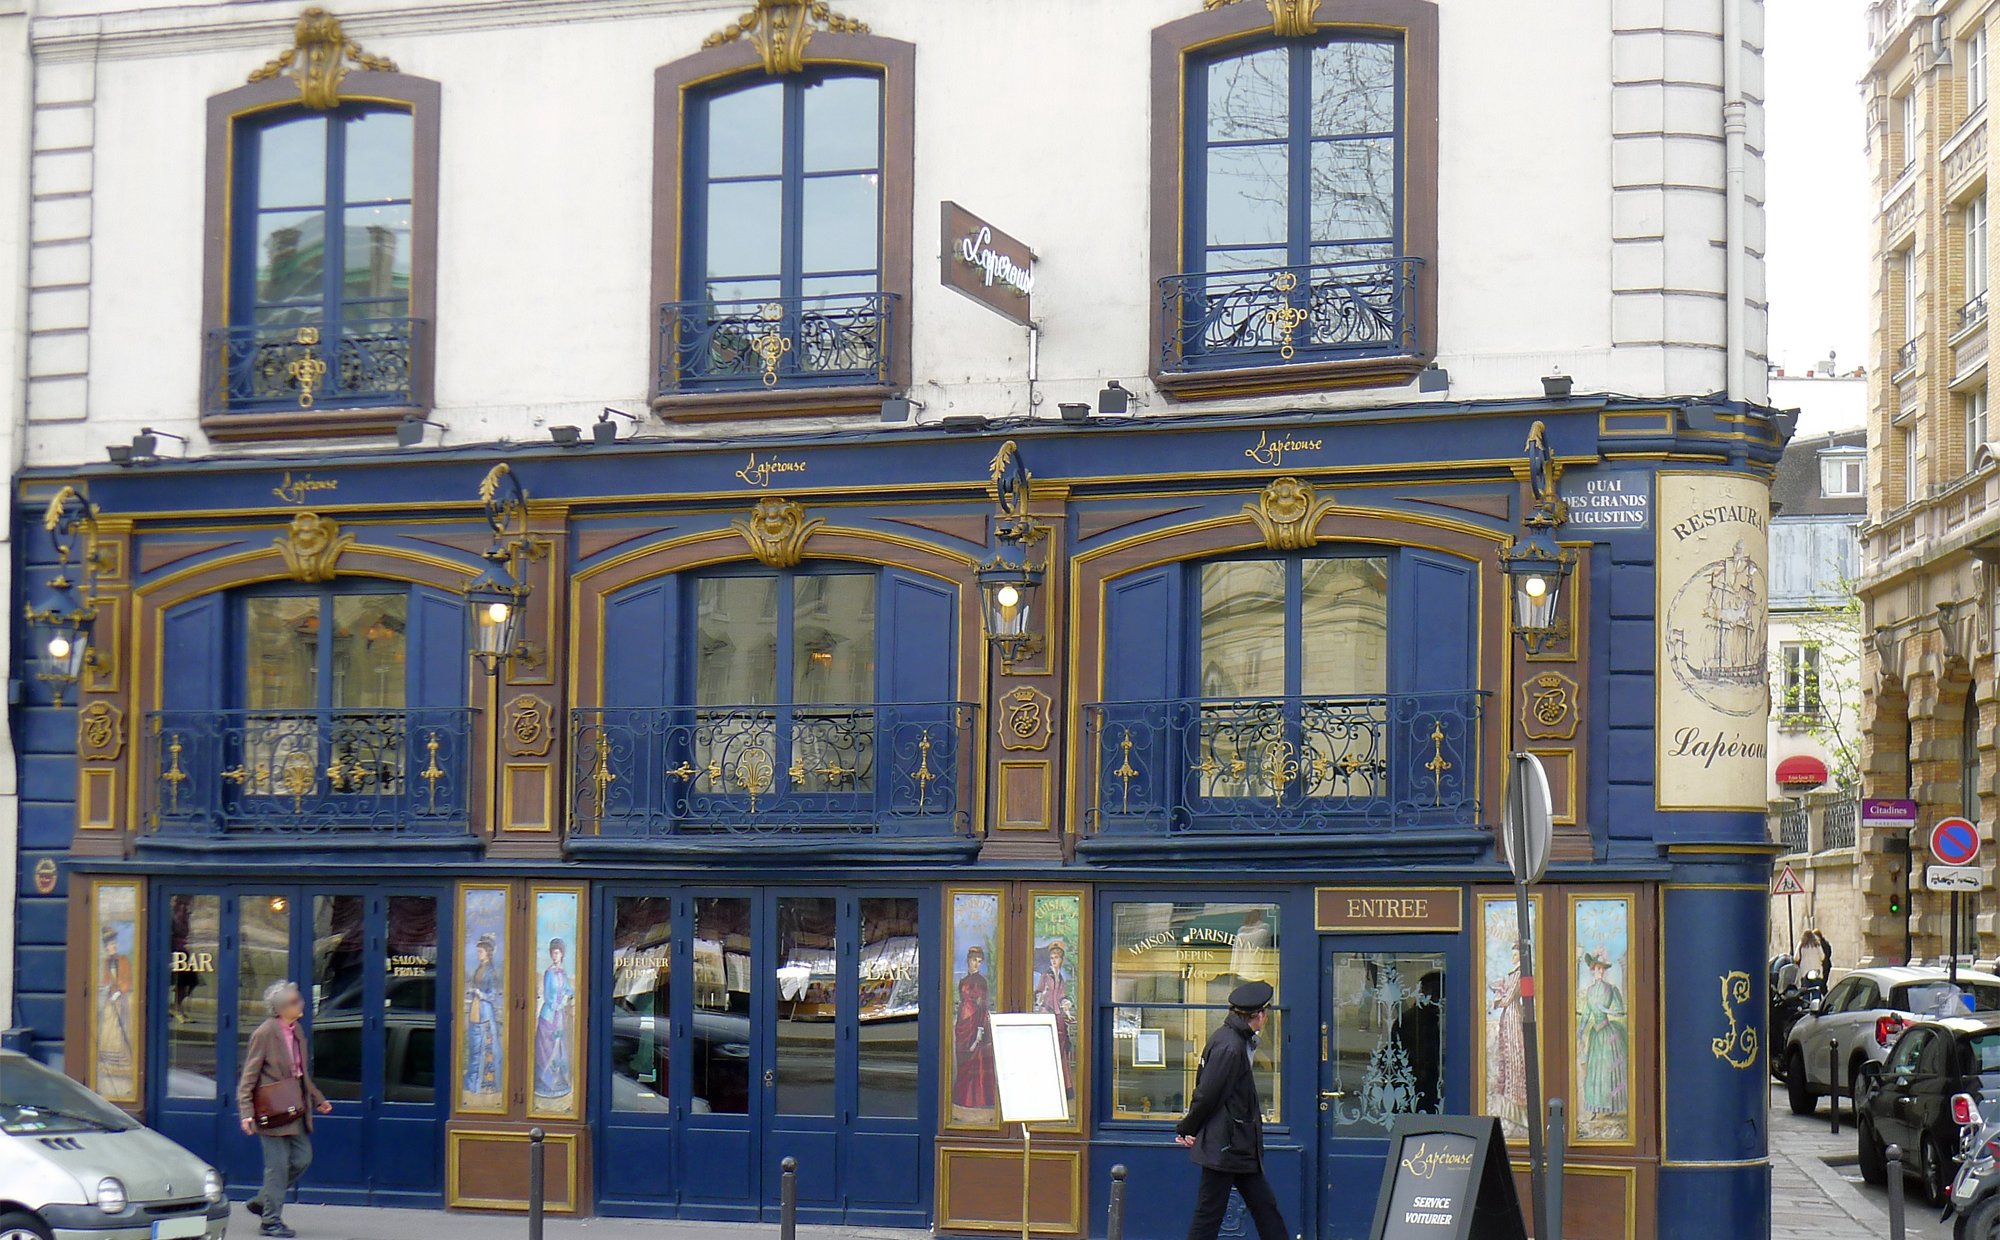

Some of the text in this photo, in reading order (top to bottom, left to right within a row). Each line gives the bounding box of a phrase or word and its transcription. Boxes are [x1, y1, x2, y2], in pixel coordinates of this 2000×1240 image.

[1245, 430, 1322, 467] Lapérouse
[735, 452, 807, 487] Lapérouse
[1587, 479, 1622, 494] QUAI
[1562, 494, 1647, 508] DES GRANDS
[1568, 510, 1644, 524] AUGUSTINS
[1870, 805, 1907, 815] Citadines
[1346, 898, 1429, 918] ENTREE
[1128, 930, 1175, 958] MAISON
[171, 951, 214, 972] BAR
[392, 955, 429, 965] SALONS
[615, 957, 669, 967] DEJEUNER
[1176, 951, 1214, 961] DEPUIS
[866, 960, 912, 980] BAR
[1181, 963, 1208, 979] 1766
[1402, 1143, 1473, 1179] Lapérouse
[1413, 1197, 1452, 1209] SERVICE
[1405, 1212, 1453, 1225] VOITURIER
